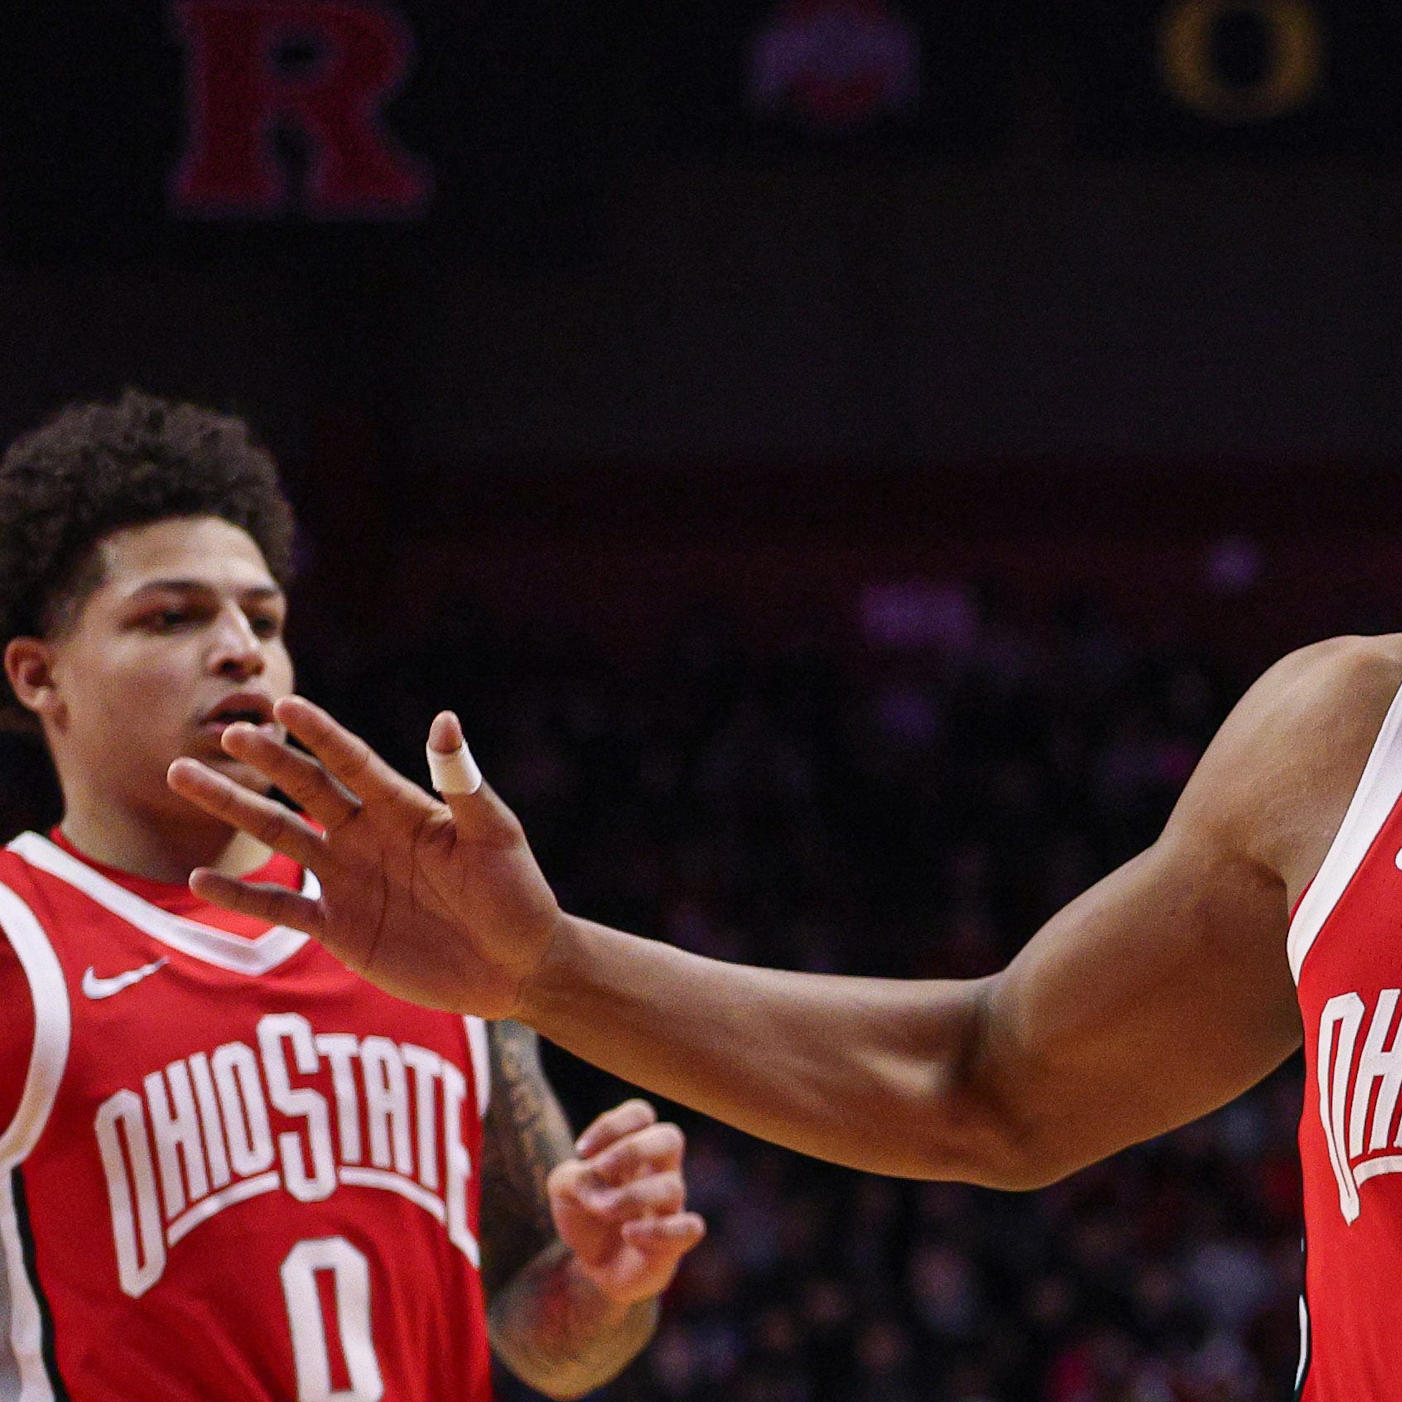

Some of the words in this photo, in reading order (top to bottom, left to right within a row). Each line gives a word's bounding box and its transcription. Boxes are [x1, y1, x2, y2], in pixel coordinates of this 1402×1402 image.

[170, 0, 435, 220] R
[95, 1042, 275, 1299] OHIO
[256, 1012, 481, 1269] STATE
